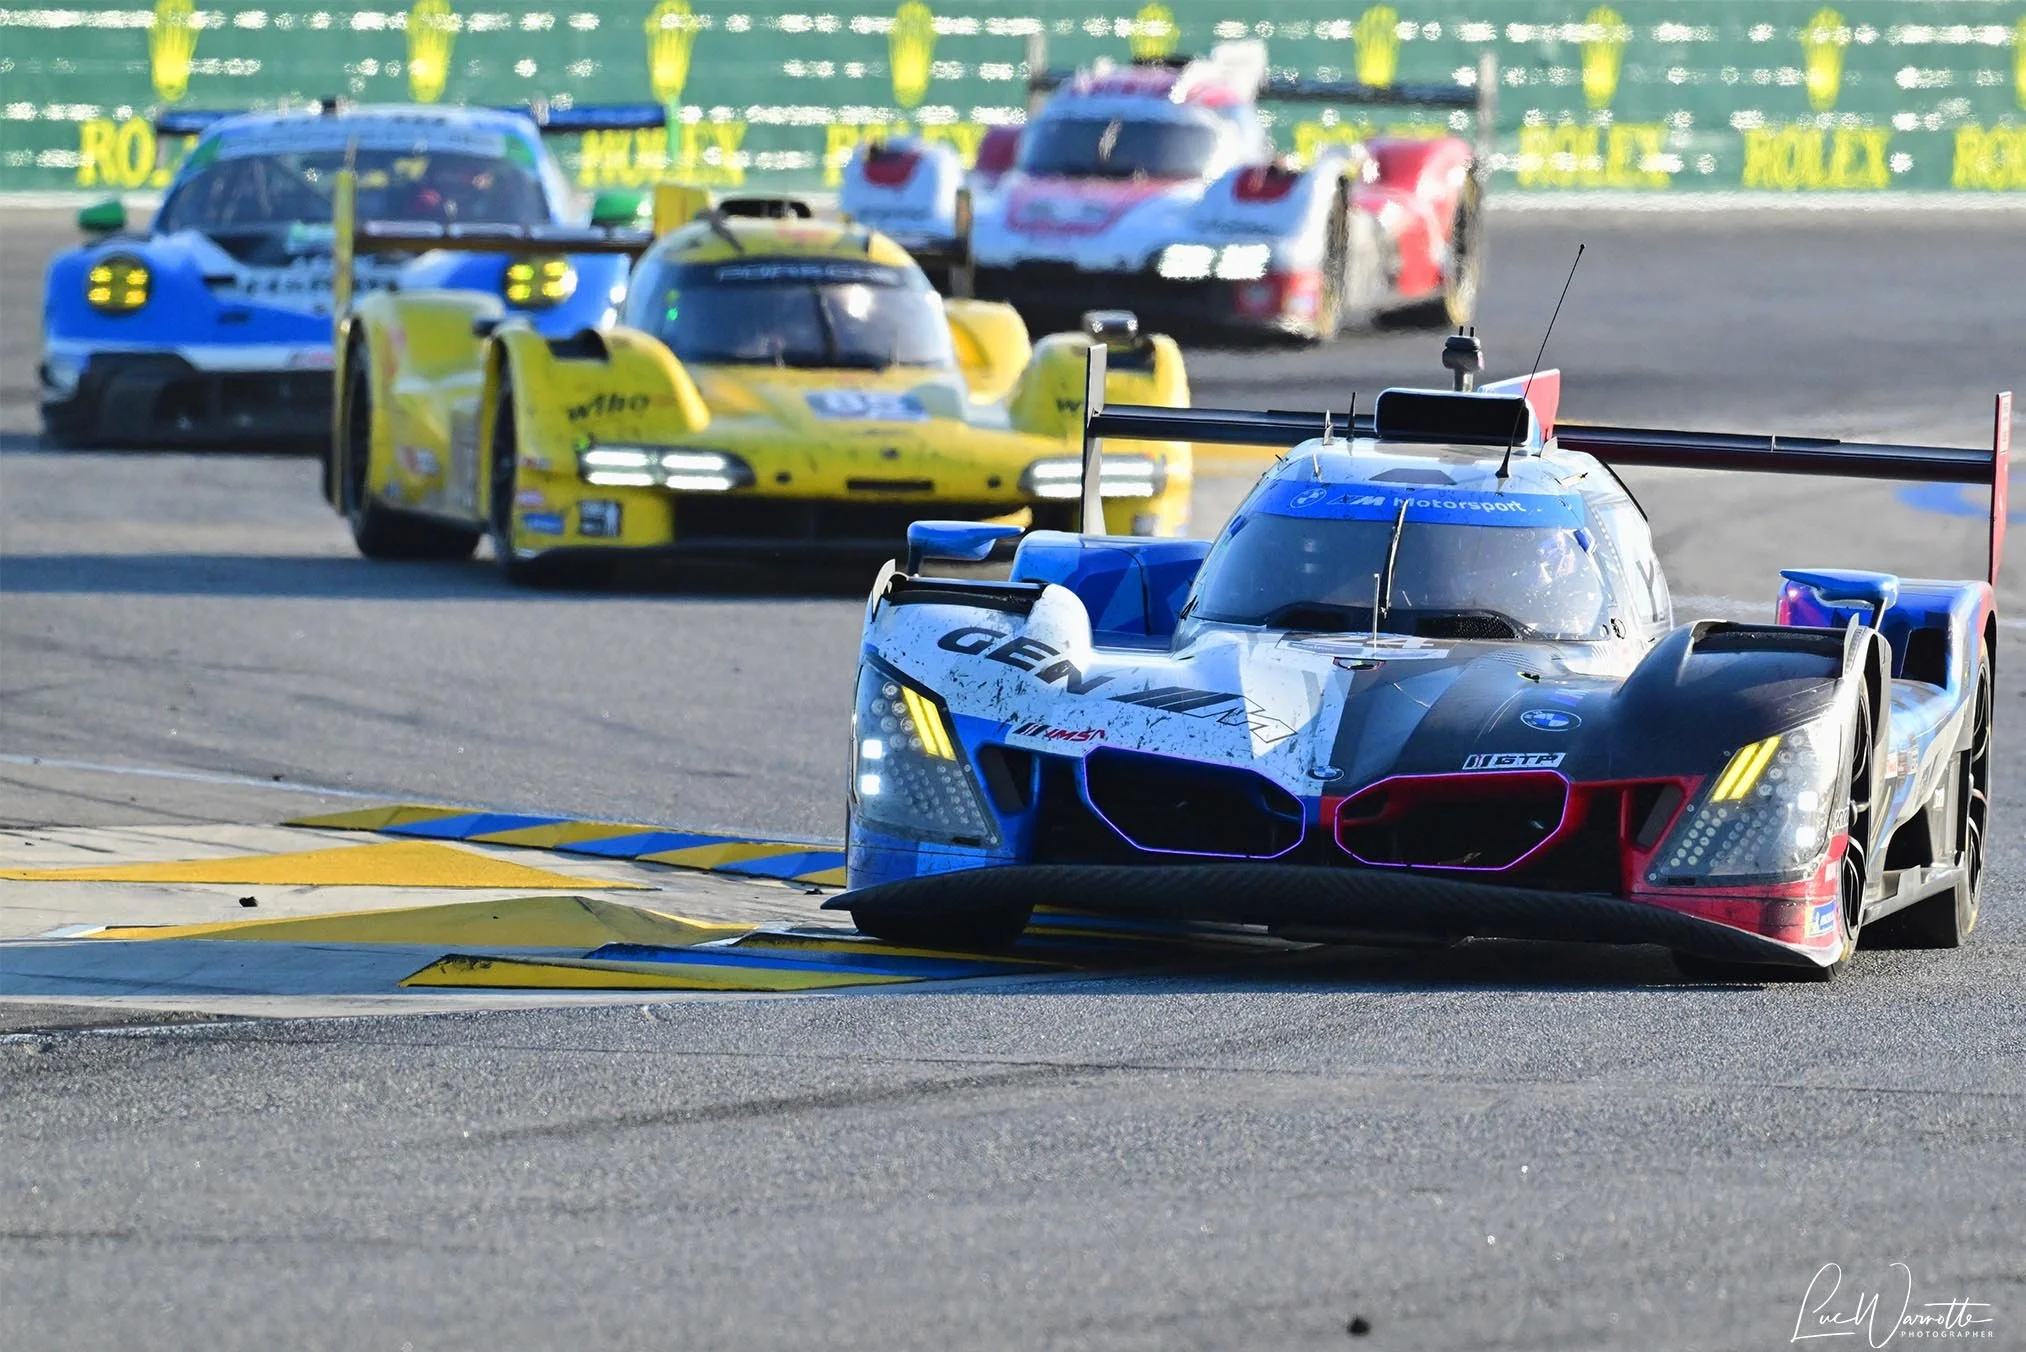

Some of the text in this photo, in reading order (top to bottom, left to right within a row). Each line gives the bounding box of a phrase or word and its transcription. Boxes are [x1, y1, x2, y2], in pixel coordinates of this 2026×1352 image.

[1743, 125, 1892, 190] ROLEX
[1393, 496, 1527, 513] Motorsport
[1044, 728, 1106, 742] IMSA
[1495, 753, 1559, 766] GTP
